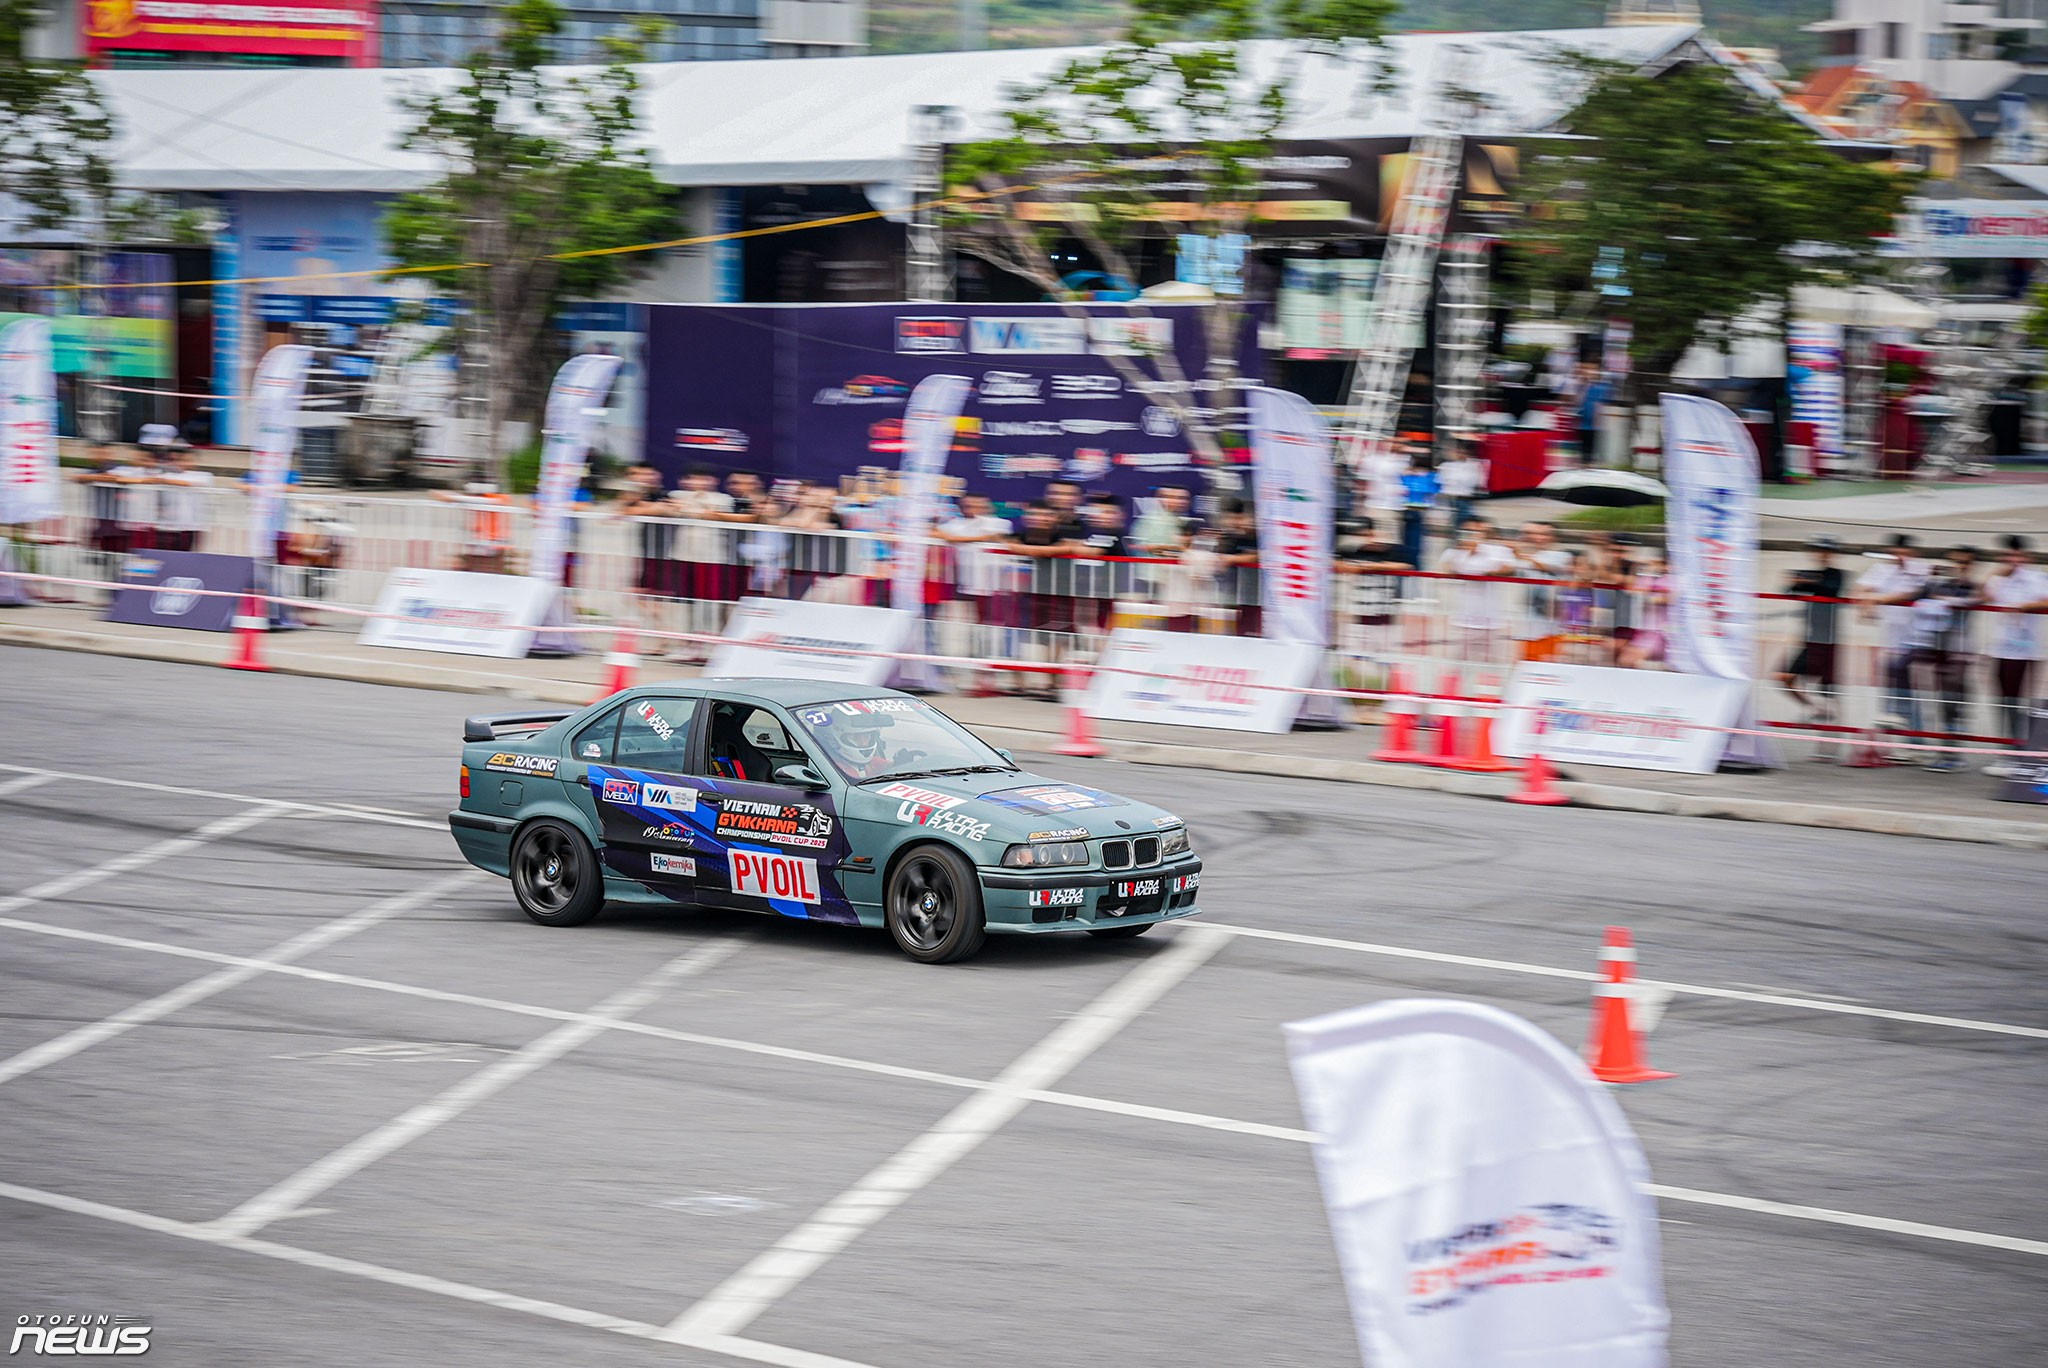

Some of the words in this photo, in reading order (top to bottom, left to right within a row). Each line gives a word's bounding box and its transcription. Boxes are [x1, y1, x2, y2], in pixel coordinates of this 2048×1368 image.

[807, 712, 827, 724] 27
[514, 755, 557, 771] RACING
[605, 791, 635, 803] MEDIA
[883, 785, 954, 808] PVOIL
[723, 799, 781, 817] VIETNAM
[718, 813, 798, 834] GYMKHANA
[934, 809, 991, 835] ULTRA
[716, 827, 771, 841] CHAMPIONSHIP
[926, 817, 983, 842] RACING
[1050, 827, 1087, 838] RACING
[771, 834, 792, 843] PVOIL
[794, 837, 808, 845] CUP
[810, 839, 826, 847] 2025
[733, 853, 815, 900] PVOIL
[1135, 880, 1159, 889] ULTRA
[1052, 888, 1083, 898] ULTRA
[1134, 887, 1159, 896] RACING
[1049, 896, 1083, 905] RACING
